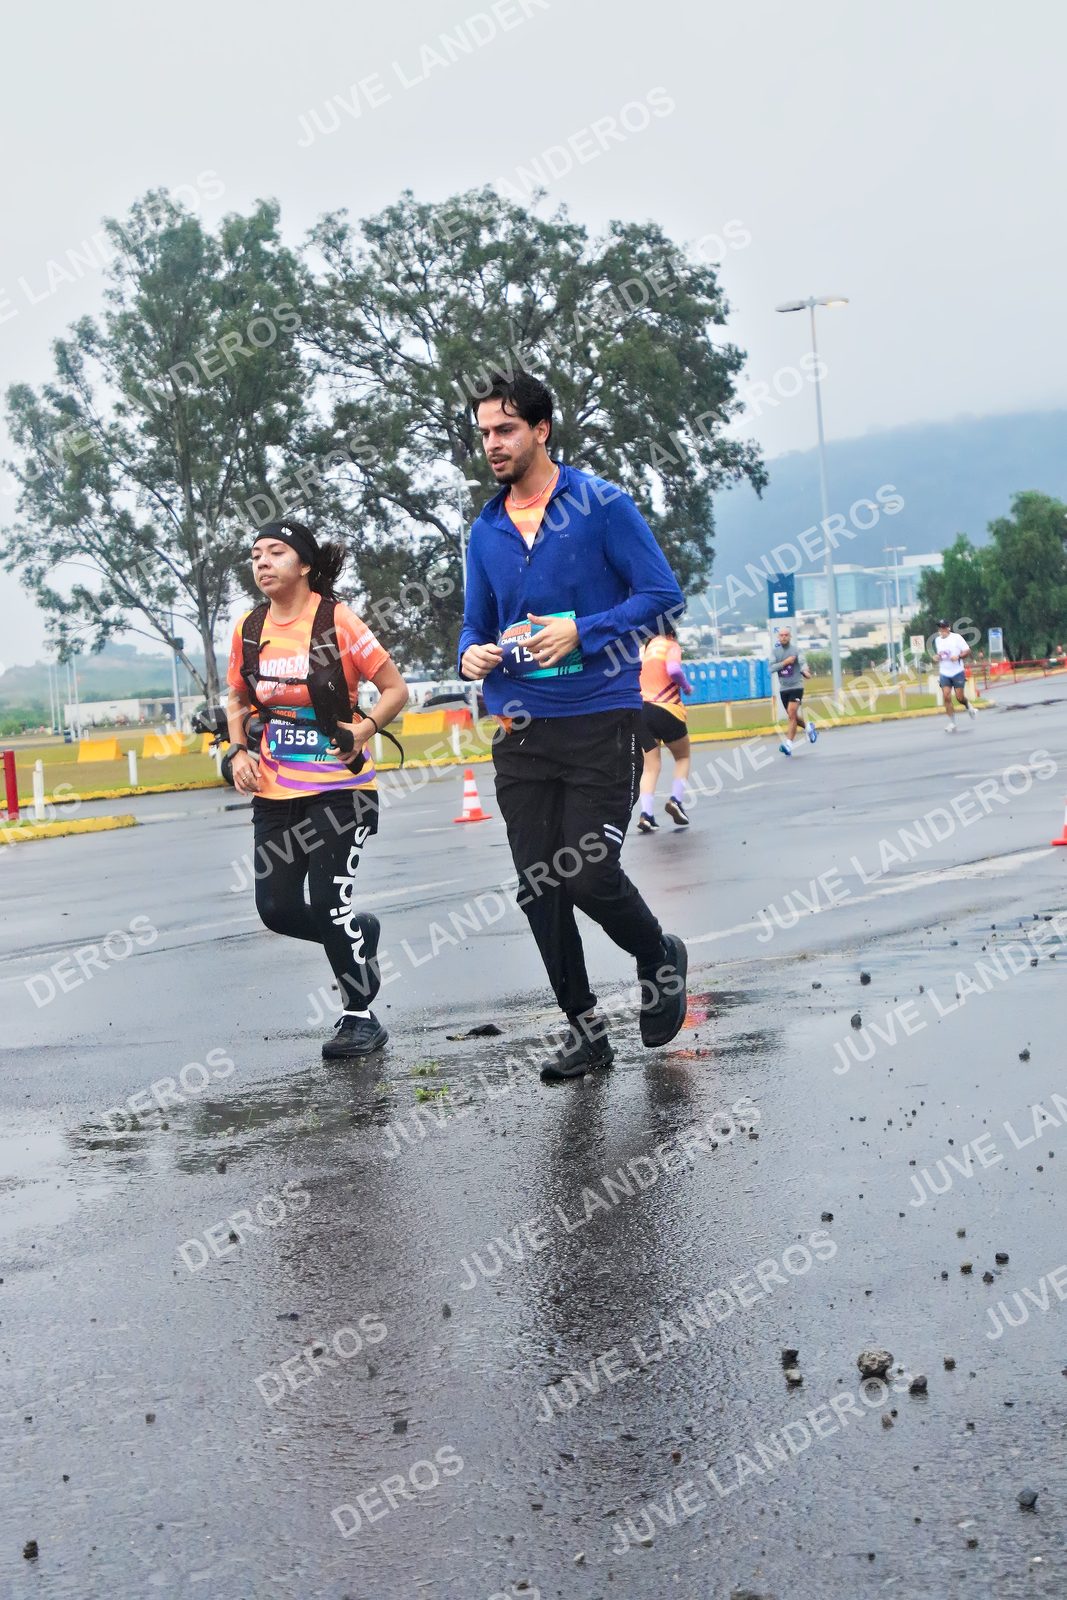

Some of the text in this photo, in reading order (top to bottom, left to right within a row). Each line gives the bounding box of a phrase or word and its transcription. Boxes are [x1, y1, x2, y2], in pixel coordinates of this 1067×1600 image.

[773, 592, 788, 612] E
[276, 729, 318, 745] 1558
[329, 826, 371, 965] adidas
